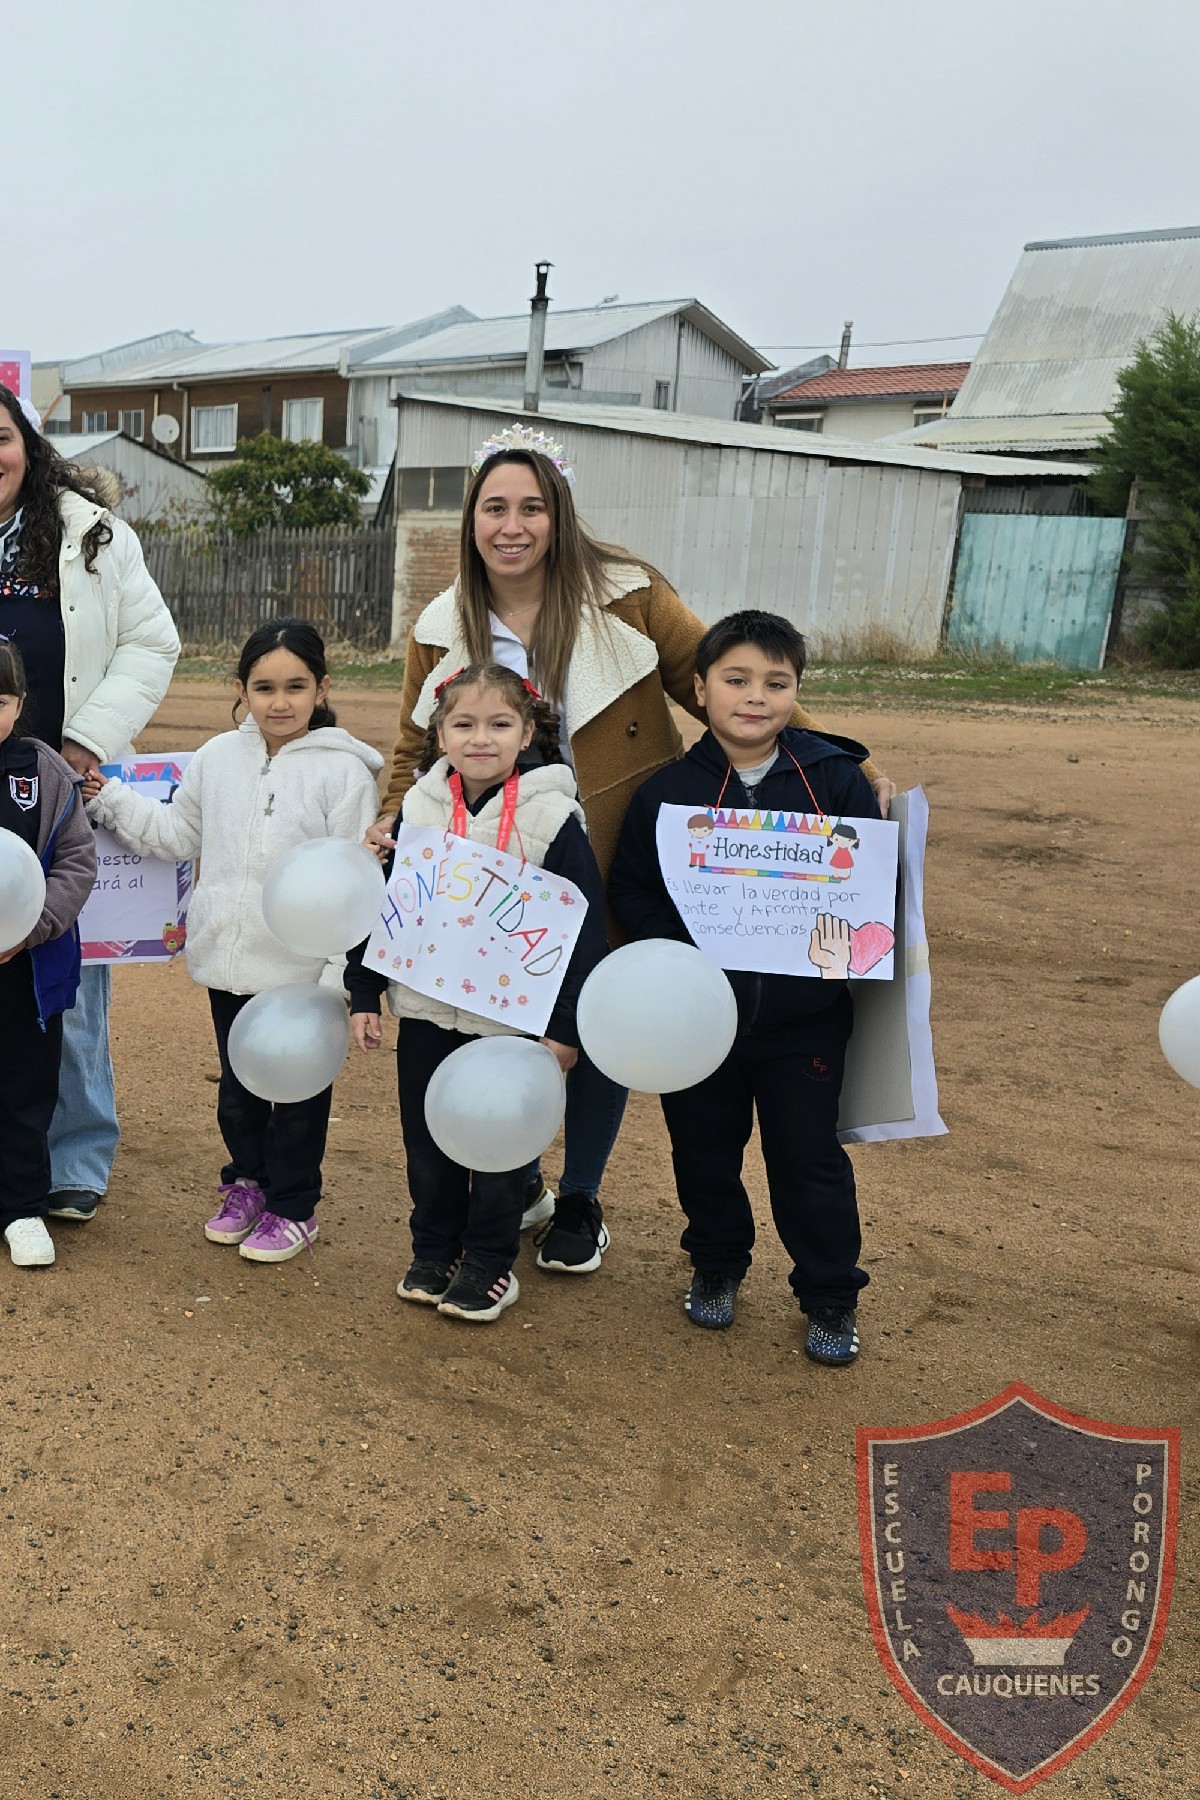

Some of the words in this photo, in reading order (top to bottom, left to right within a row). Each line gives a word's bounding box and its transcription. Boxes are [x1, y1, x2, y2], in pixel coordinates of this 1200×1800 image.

[713, 837, 824, 864] Honestidad
[682, 880, 731, 896] llevar
[742, 882, 758, 900] la
[763, 886, 821, 902] verdad
[828, 891, 861, 908] por
